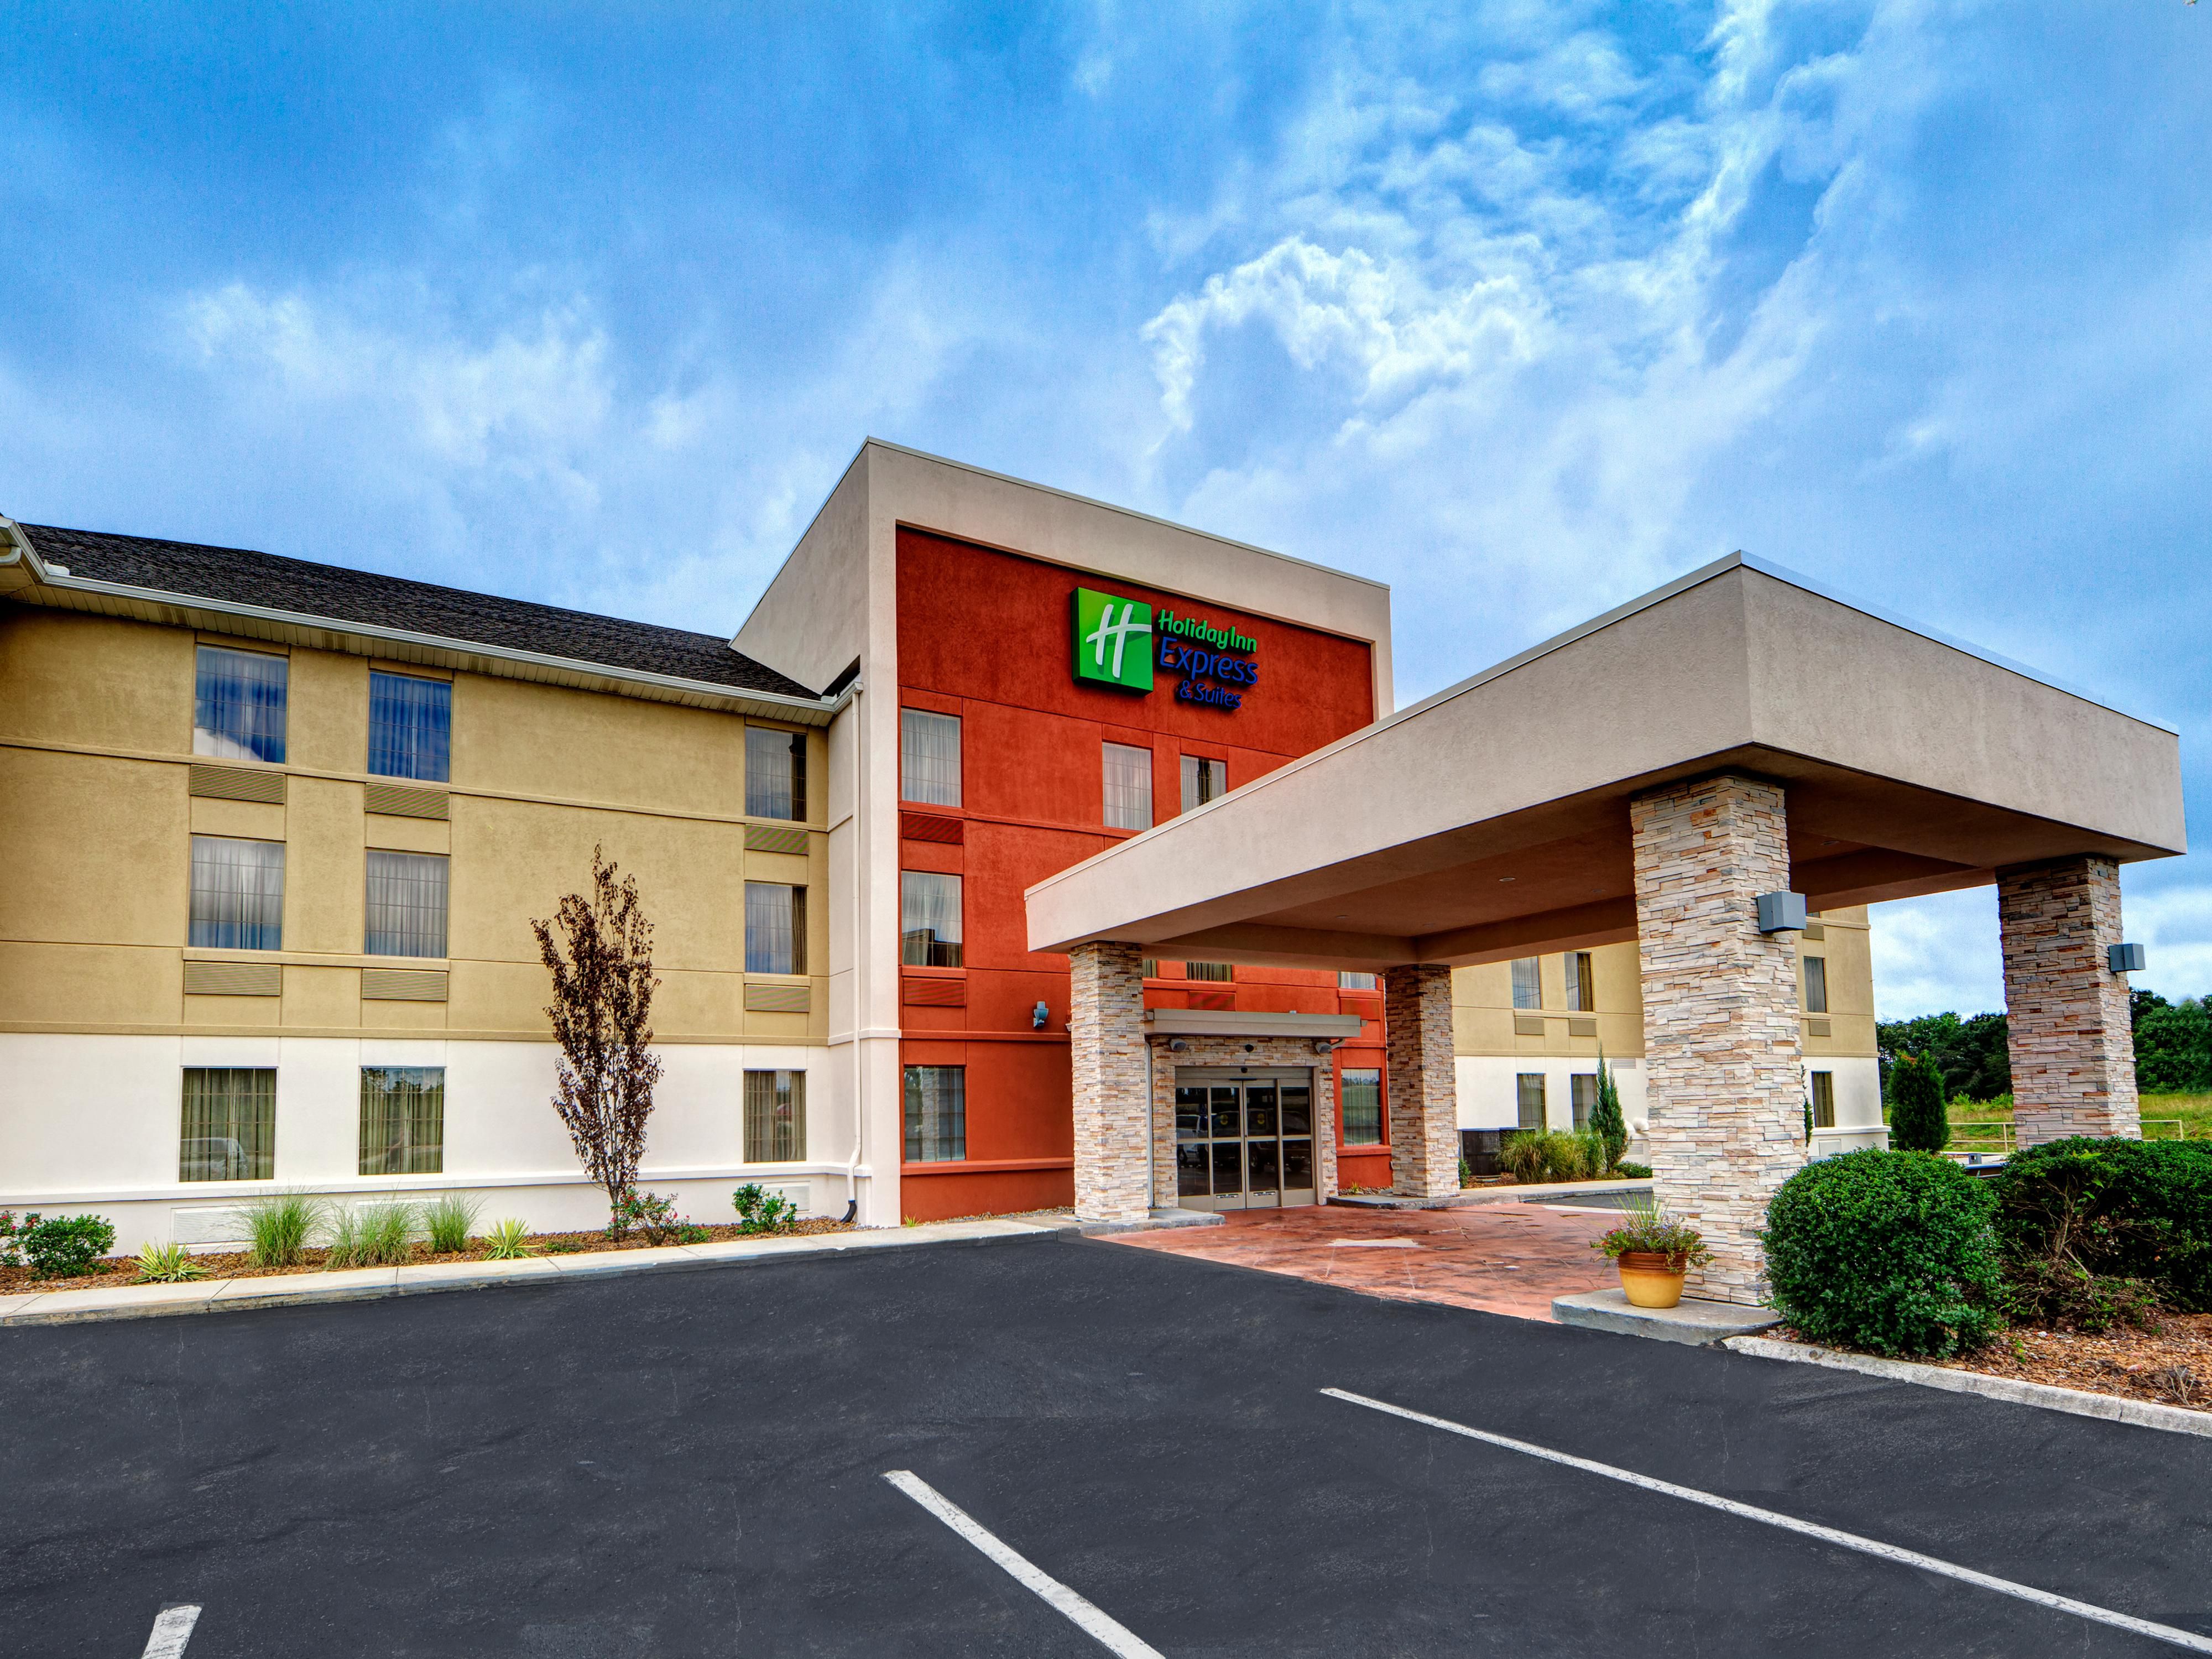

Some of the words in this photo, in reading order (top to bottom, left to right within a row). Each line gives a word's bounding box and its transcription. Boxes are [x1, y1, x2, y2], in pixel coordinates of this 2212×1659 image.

[1160, 636, 1259, 685] Express
[1180, 680, 1192, 700] &
[1194, 682, 1243, 709] Suites
